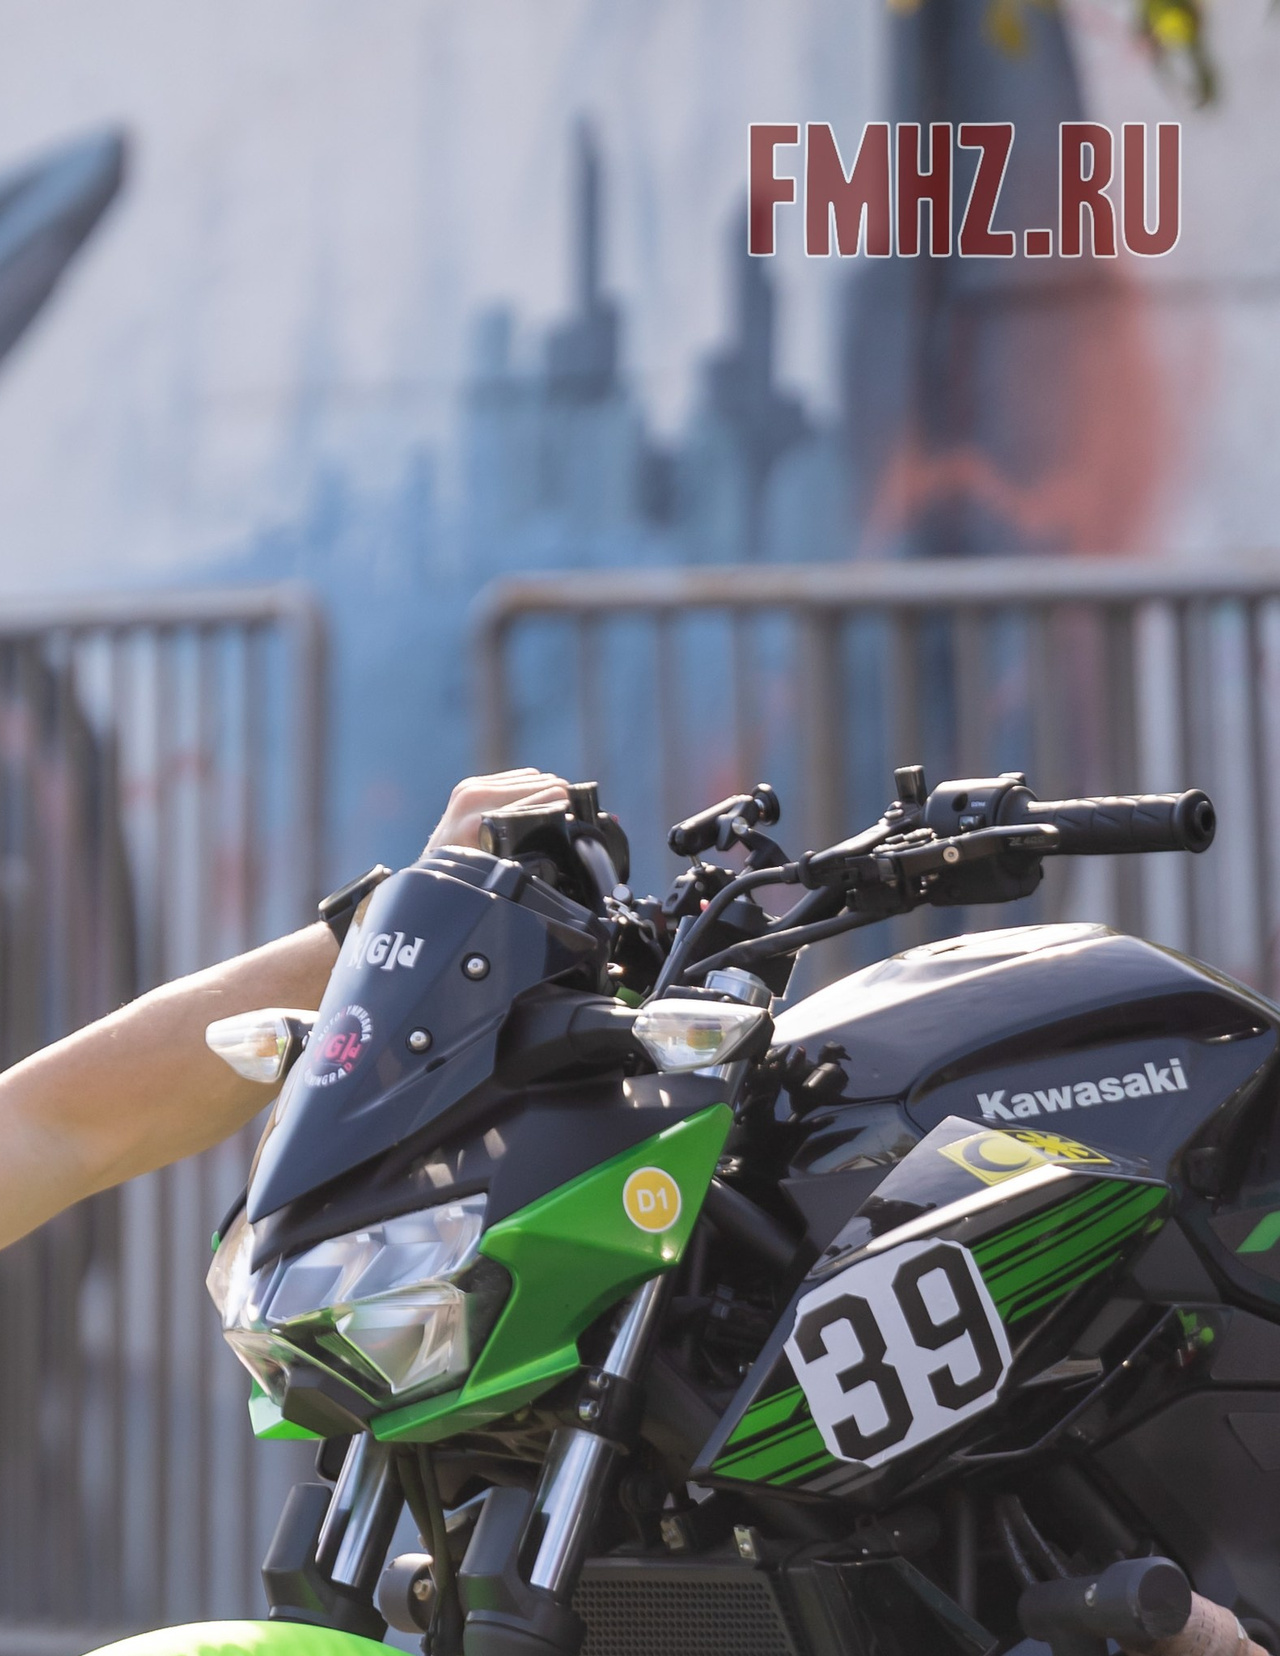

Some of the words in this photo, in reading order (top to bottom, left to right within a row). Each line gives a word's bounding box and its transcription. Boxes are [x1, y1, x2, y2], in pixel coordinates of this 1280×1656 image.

[976, 1058, 1189, 1121] Kawasaki
[636, 1187, 669, 1213] D1
[793, 1243, 1005, 1461] 39
